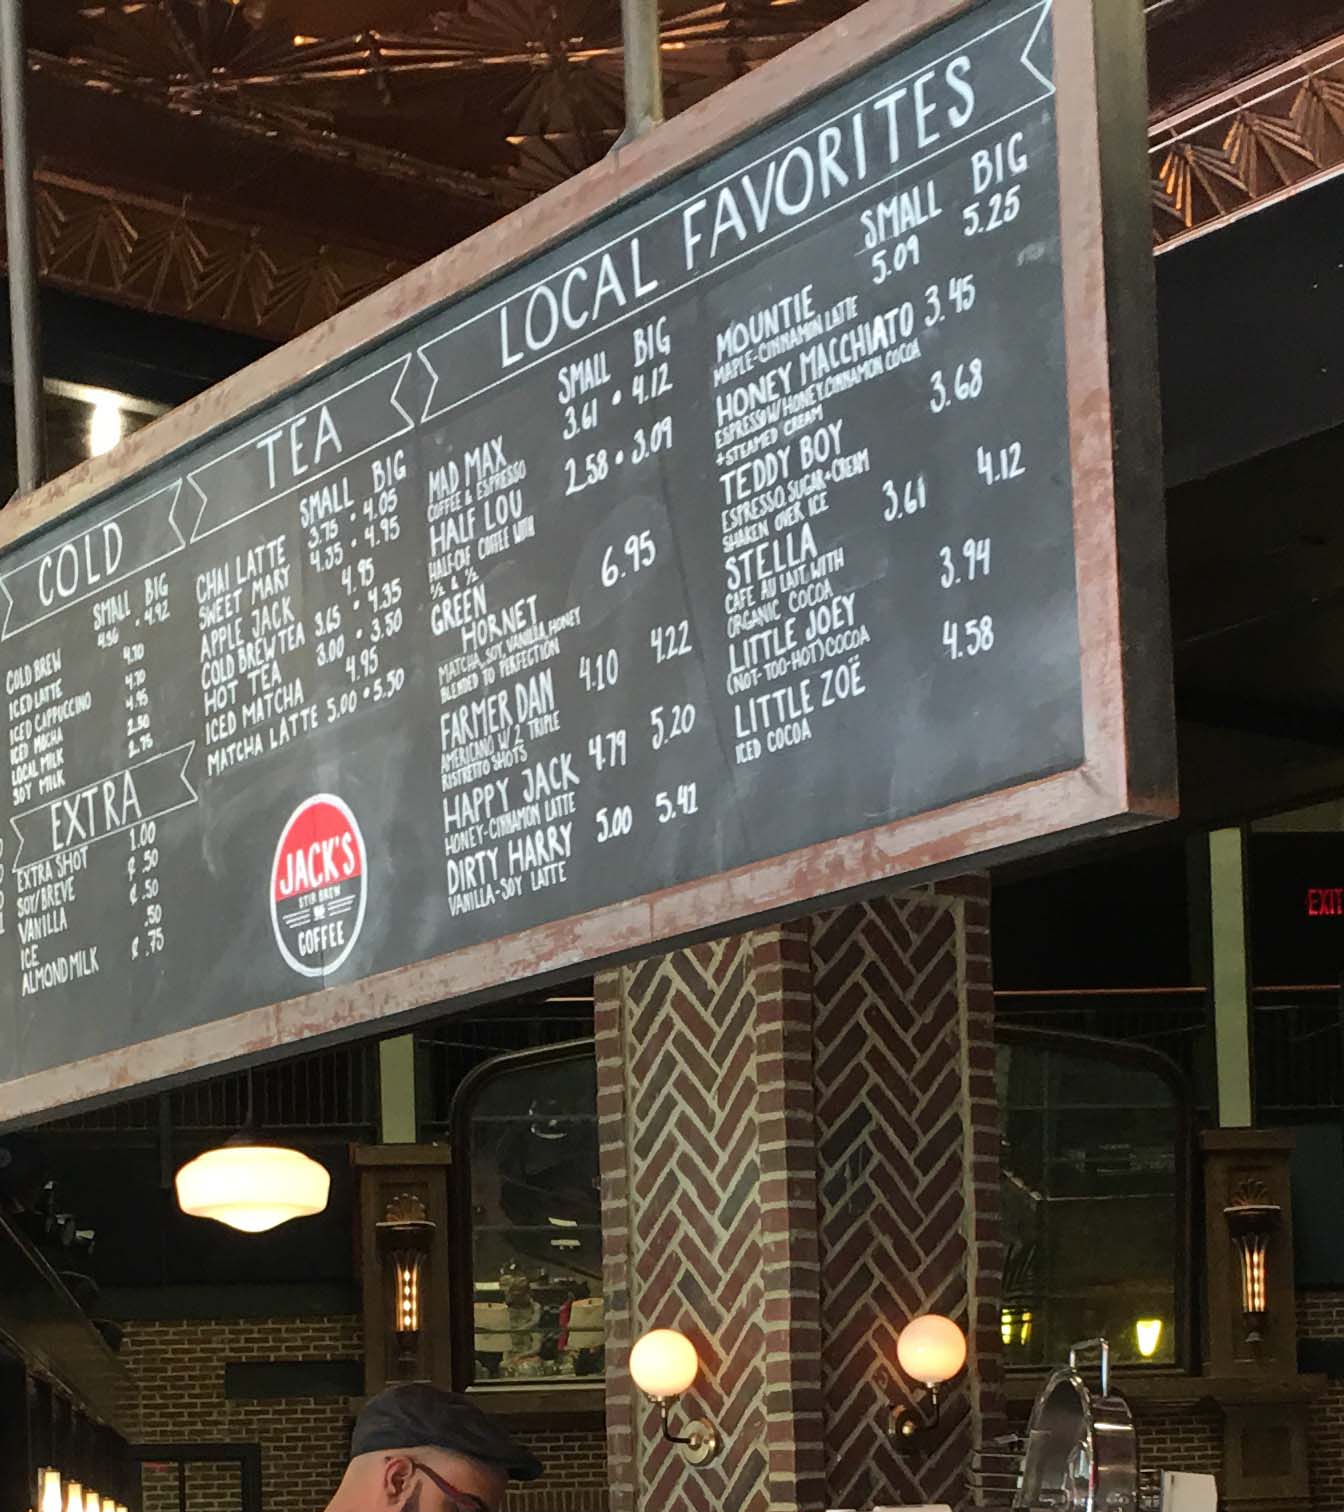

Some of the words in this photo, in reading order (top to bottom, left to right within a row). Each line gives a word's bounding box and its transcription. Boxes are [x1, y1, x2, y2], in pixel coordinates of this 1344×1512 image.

[501, 239, 658, 369] LOCAL
[681, 55, 977, 271] FAVORITES
[860, 180, 943, 250] SMALL
[971, 131, 1028, 195] BIG
[871, 238, 920, 285] 5.09
[962, 184, 1021, 237] 5.25
[558, 351, 611, 404] SMALL
[633, 316, 671, 368] BIG
[716, 283, 815, 363] MOUNTIE
[716, 361, 793, 427] HONEY
[799, 301, 915, 387] MACCHIATO
[924, 273, 976, 328] 3.45
[563, 398, 598, 440] 3.61
[632, 362, 673, 405] 4.12
[719, 445, 791, 505] TEDDY
[799, 418, 844, 471] BOY
[929, 356, 984, 414] 3.68
[783, 403, 824, 436] CREAM
[257, 405, 343, 489] TEA
[428, 460, 460, 504] MAD
[464, 435, 508, 487] MAX
[299, 476, 354, 529] SMALL
[371, 449, 407, 494] BIG
[427, 491, 462, 523] COFFEE
[429, 506, 477, 558] HALF
[484, 488, 523, 532] LOU
[564, 449, 609, 496] 2.58
[632, 416, 673, 465] 3.09
[722, 519, 770, 553] SHAKEN
[774, 501, 806, 531] OVER
[807, 491, 830, 517] ICE
[724, 521, 818, 590] STELLA
[882, 475, 926, 523] 3.61
[976, 440, 1025, 486] 4.12
[39, 521, 123, 607] COLD
[196, 562, 230, 605] CHAI
[236, 534, 287, 584] LATTE
[308, 518, 338, 549] 3.75
[363, 487, 398, 522] 4.05
[199, 588, 243, 631] SWEET
[252, 564, 290, 605] MARY
[310, 542, 343, 573] 4.35
[364, 515, 400, 548] 4.95
[430, 582, 488, 637] GREEN
[601, 529, 657, 588] 6.95
[724, 585, 756, 615] CAFE
[761, 576, 777, 601] AU
[779, 564, 807, 594] LAIT
[810, 546, 845, 580] WITH
[93, 589, 131, 631] SMALL
[144, 572, 169, 607] BIG
[200, 618, 244, 663] APPLE
[251, 596, 295, 638] JACK
[341, 557, 374, 596] 4.95
[201, 653, 235, 690] COLD
[314, 604, 341, 637] 3.65
[368, 577, 402, 613] 4.35
[461, 594, 538, 654] HORNET
[727, 599, 782, 639] ORGANIC
[788, 577, 834, 614] COCOA
[729, 617, 798, 676] LITTLE
[805, 591, 856, 641] JOEY
[939, 537, 992, 590] 3.94
[824, 624, 871, 657] COCOA
[6, 664, 32, 695] COLD
[33, 648, 62, 683] BREW
[9, 693, 33, 722] ICED
[34, 677, 63, 709] LATTE
[205, 680, 239, 716] HOT
[247, 660, 282, 696] TEA
[316, 634, 345, 667] 3.00
[370, 608, 403, 643] 3.50
[205, 711, 237, 745] ICED
[242, 678, 305, 728] MATCHA
[345, 646, 379, 683] 4.95
[440, 689, 513, 751] FARMER
[514, 667, 556, 724] DAN
[579, 647, 619, 691] 4.10
[650, 620, 693, 664] 4.22
[482, 666, 496, 687] TO
[499, 637, 560, 679] PERFECTION
[735, 678, 815, 739] LITTLE
[820, 654, 867, 708] ZOË
[942, 614, 995, 661] 4.58
[9, 719, 33, 746] ICED
[34, 690, 92, 733] CAPPUCCINO
[207, 733, 263, 777] MATCHA
[270, 704, 319, 750] LATTE
[327, 690, 358, 723] 5.00
[373, 667, 405, 701] 5.50
[735, 738, 761, 765] ICED
[766, 717, 812, 753] COCOA
[11, 759, 39, 787] LOCAL
[40, 748, 65, 774] MILK
[13, 782, 32, 806] SOY
[39, 769, 66, 795] MILK
[443, 777, 509, 833] HAPPY
[521, 752, 580, 803] JACK
[588, 729, 627, 771] 4.79
[650, 704, 696, 751] 5.20
[493, 744, 528, 775] SHOTS
[51, 769, 142, 851] EXTRA
[545, 792, 576, 821] LATTE
[17, 860, 53, 893] EXTRA
[55, 846, 88, 878] SHOT
[129, 821, 156, 851] 1.00
[279, 831, 356, 895] JACK'S
[447, 846, 499, 895] DIRTY
[508, 821, 573, 876] HARRY
[596, 805, 632, 843] 5.00
[530, 861, 567, 891] LATTE
[16, 875, 76, 918] SOY/BREVE
[18, 906, 68, 945] VANILLA
[1308, 888, 1343, 915] EXIT
[20, 944, 41, 971] ICE
[298, 920, 344, 957] COFFEE
